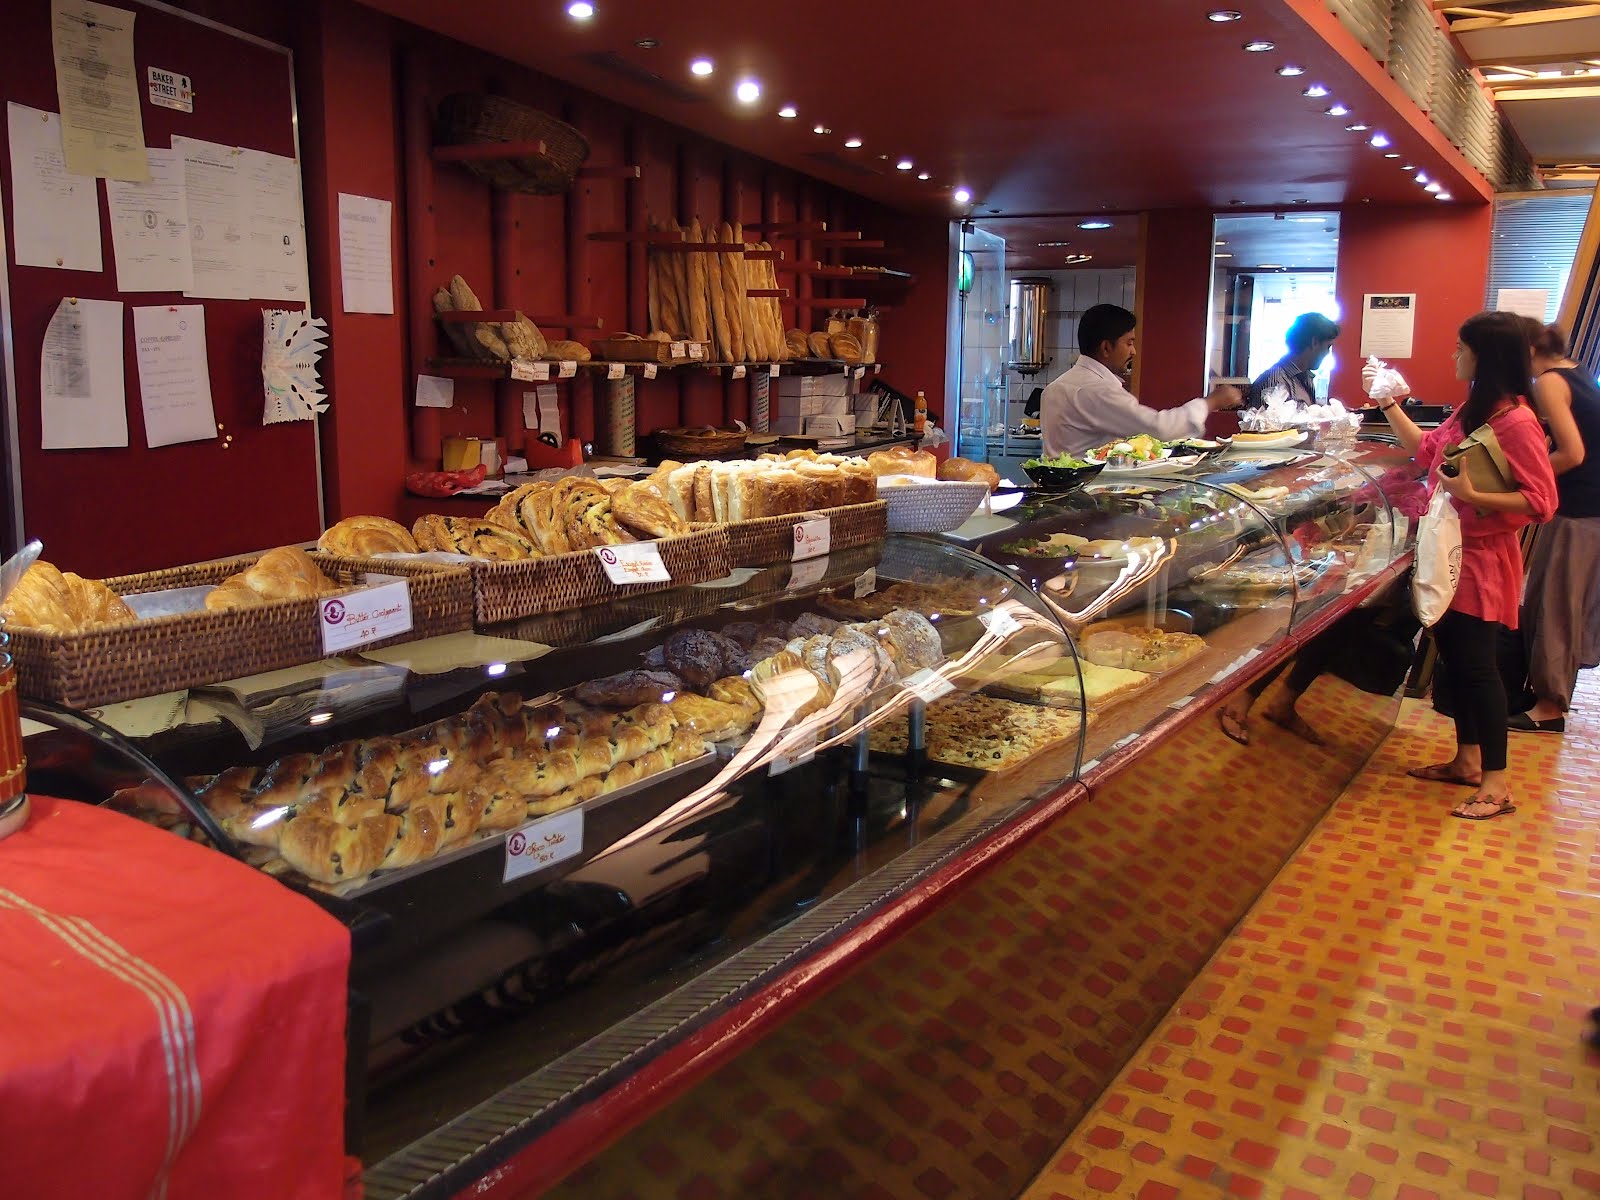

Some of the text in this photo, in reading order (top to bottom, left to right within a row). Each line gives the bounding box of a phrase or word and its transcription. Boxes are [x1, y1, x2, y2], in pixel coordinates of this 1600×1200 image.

[152, 71, 174, 86] BAKER
[153, 83, 177, 97] STREET
[345, 610, 369, 626] Butter
